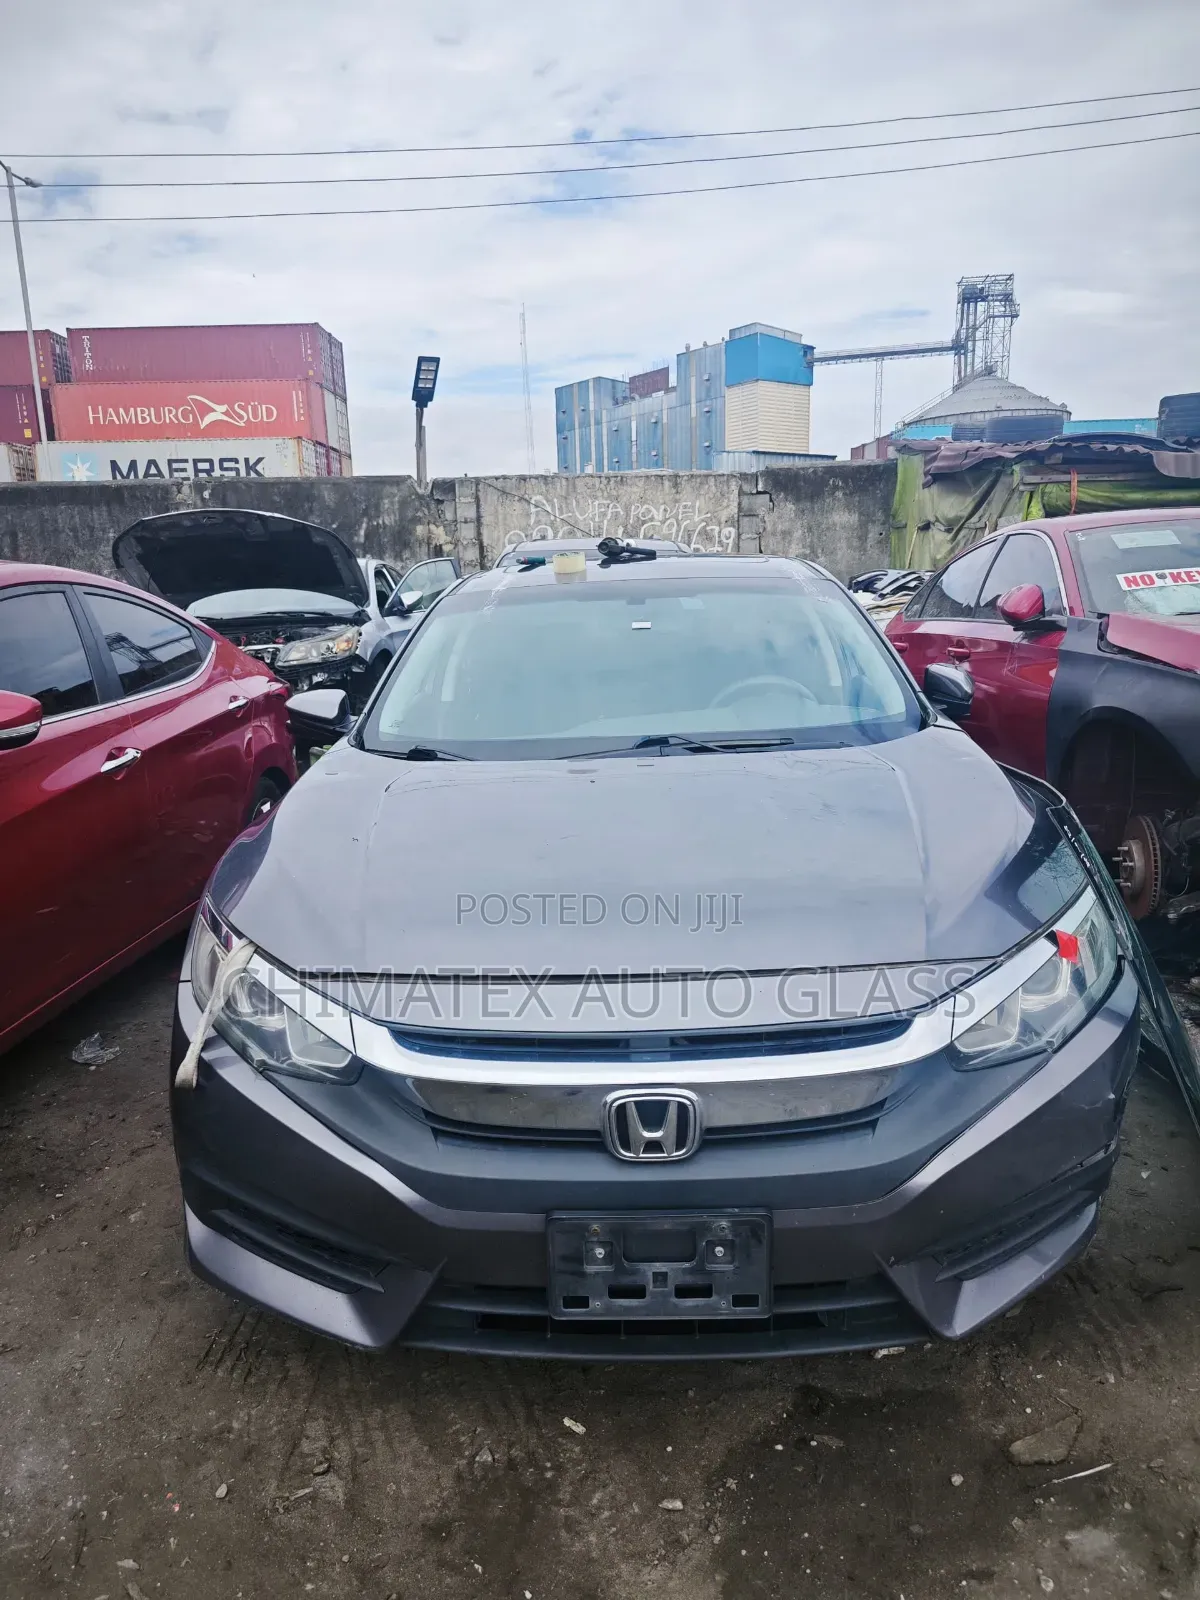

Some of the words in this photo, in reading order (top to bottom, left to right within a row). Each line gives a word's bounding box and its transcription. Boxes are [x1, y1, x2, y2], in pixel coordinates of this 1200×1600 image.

[82, 335, 93, 371] TRITON
[88, 405, 193, 425] HAMBURG
[234, 401, 277, 423] SÜD
[109, 457, 266, 481] MAERSK
[1123, 574, 1155, 588] NO
[1168, 570, 1200, 584] KE
